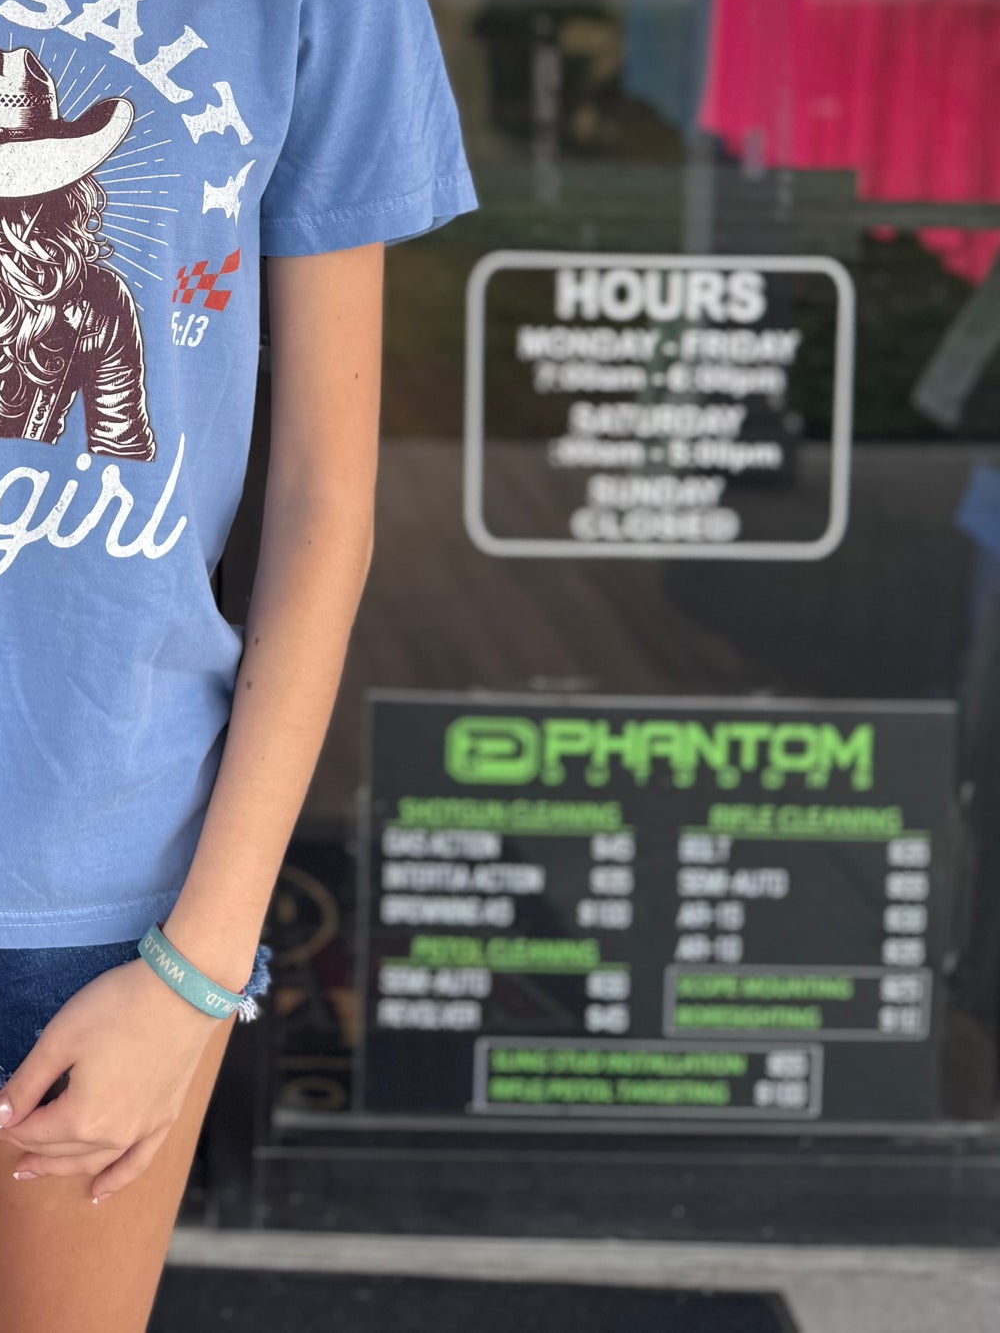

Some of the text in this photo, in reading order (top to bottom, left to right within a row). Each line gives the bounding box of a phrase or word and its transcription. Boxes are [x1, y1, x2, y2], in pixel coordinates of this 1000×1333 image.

[554, 268, 769, 323] HOURS
[515, 324, 661, 362] MONDAY
[680, 327, 801, 364] FRIDAY
[569, 401, 747, 439] SATURDAY
[569, 507, 741, 543] CLOSED
[543, 718, 875, 769] PHANTOM
